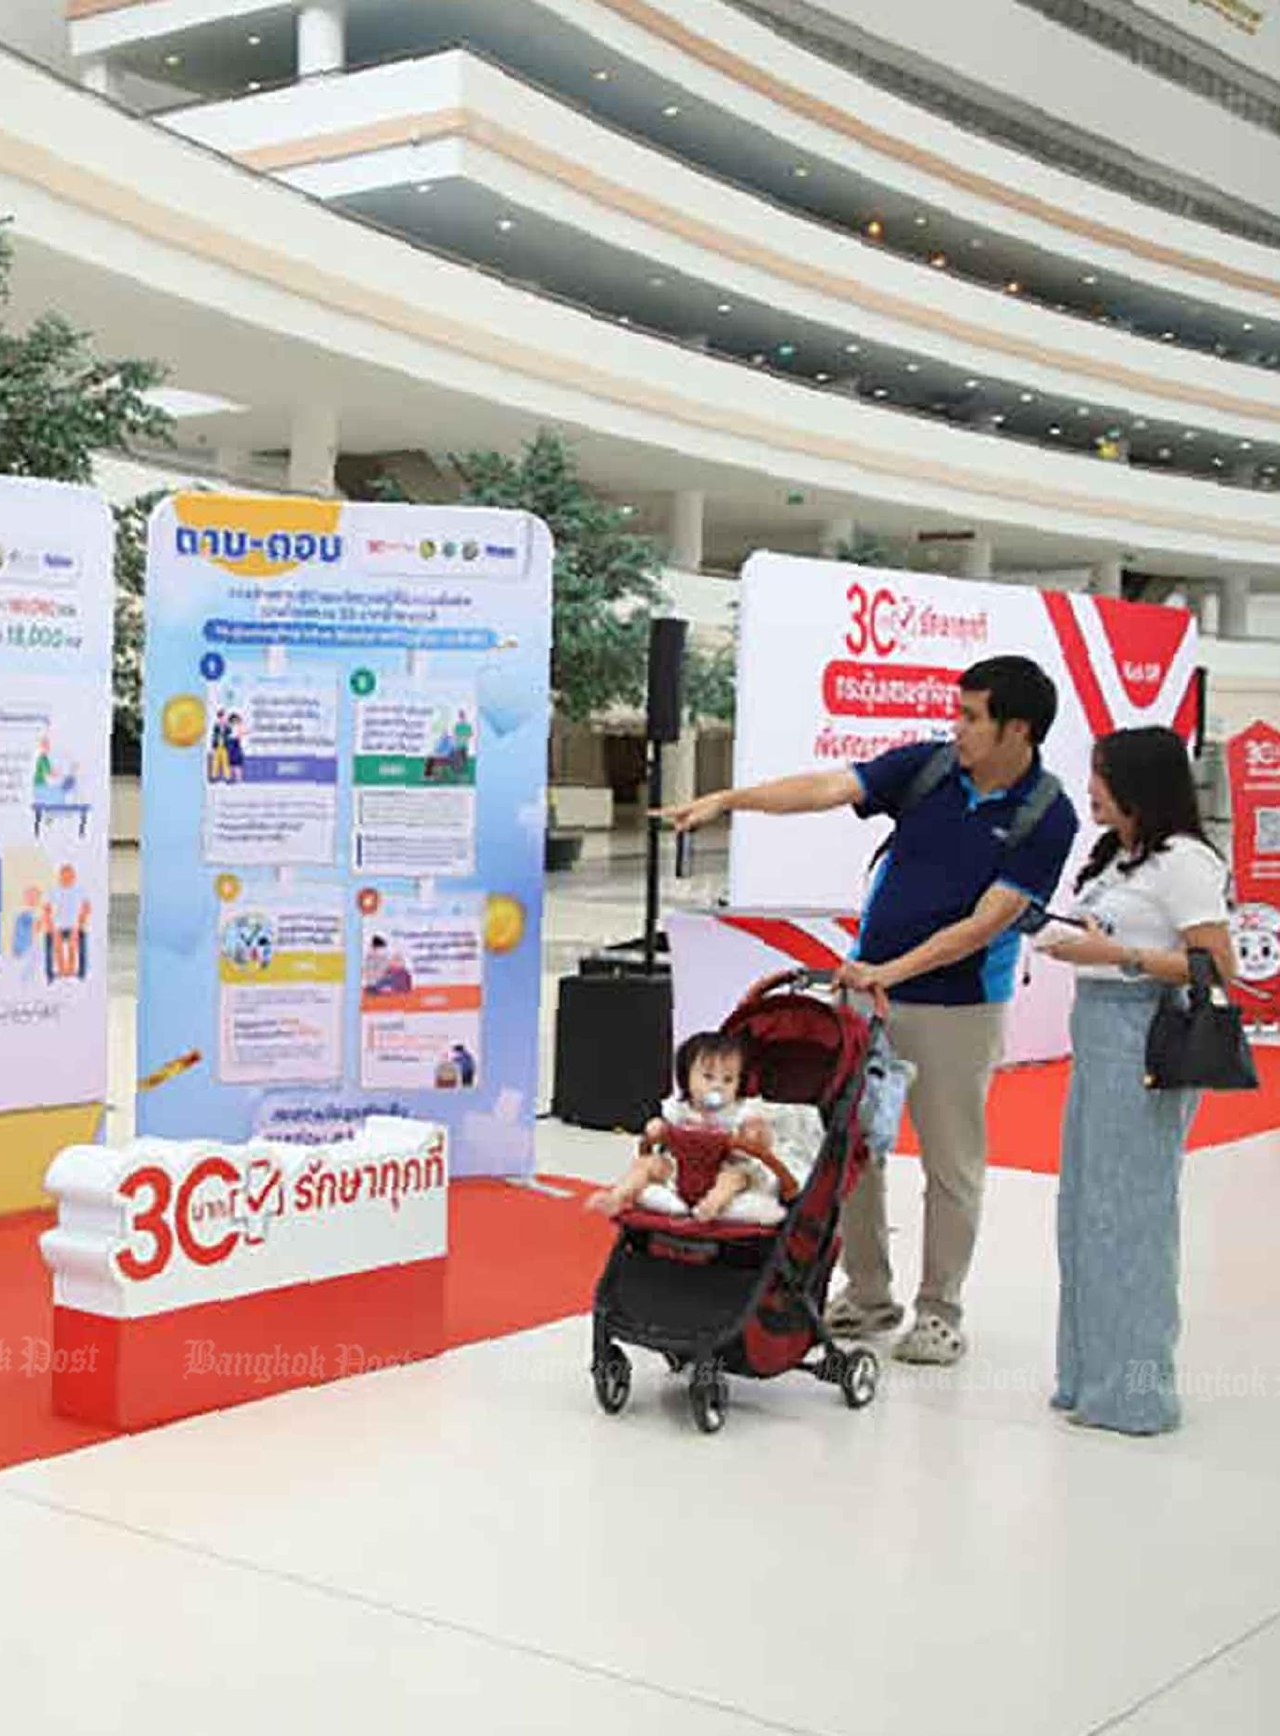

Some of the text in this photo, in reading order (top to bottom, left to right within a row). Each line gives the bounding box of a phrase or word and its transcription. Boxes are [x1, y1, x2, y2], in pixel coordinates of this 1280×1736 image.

[294, 1132, 445, 1213] รักษาทุกที่
